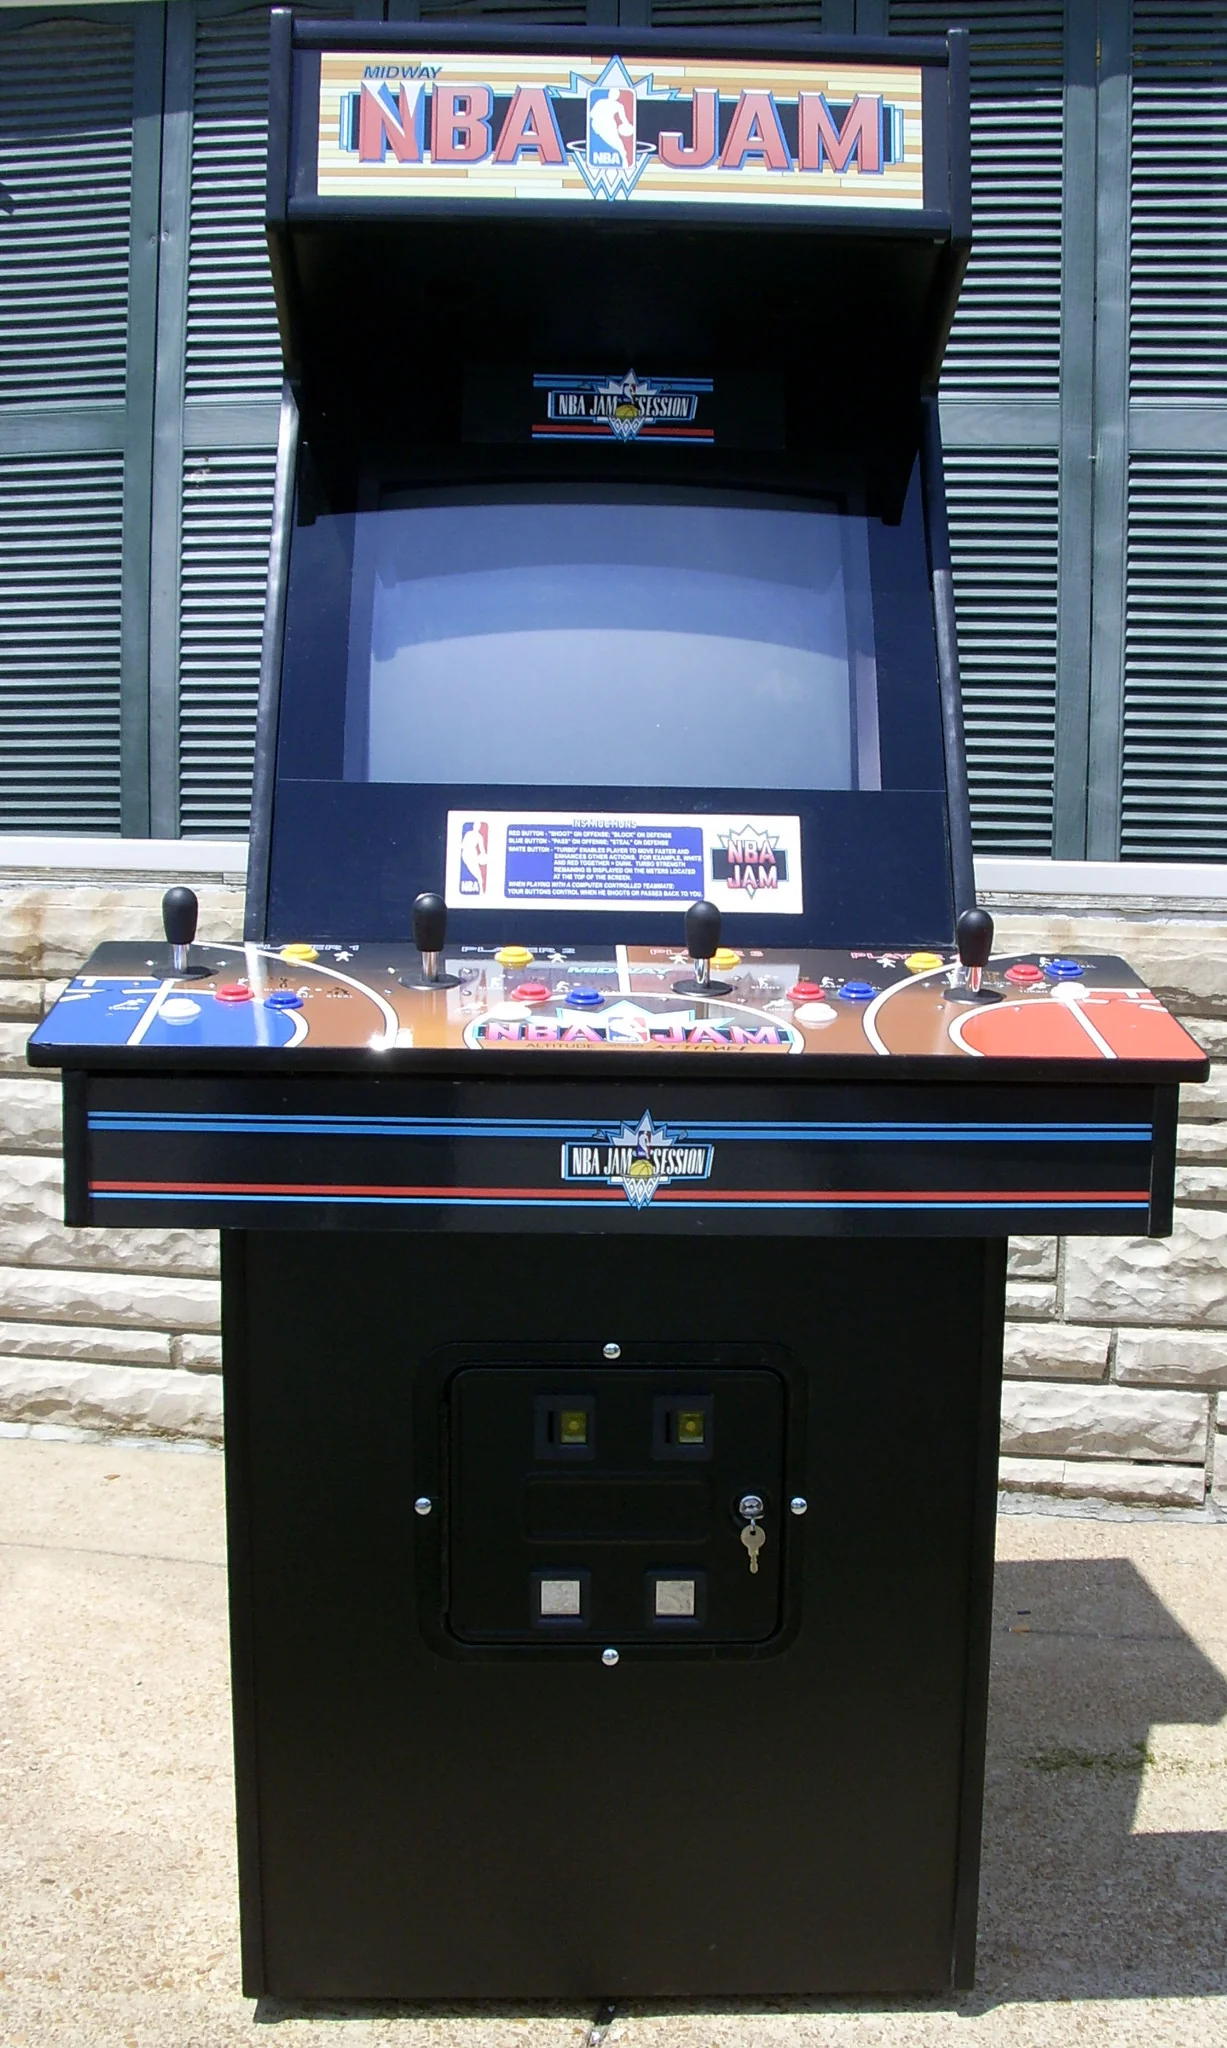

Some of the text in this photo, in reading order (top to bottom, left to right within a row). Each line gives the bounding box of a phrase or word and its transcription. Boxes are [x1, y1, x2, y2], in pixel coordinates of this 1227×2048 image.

[363, 65, 443, 80] MIDWAY
[359, 81, 886, 176] NBA JAM
[592, 151, 620, 166] NBA
[558, 394, 690, 418] NBA JAM SESSION
[572, 819, 637, 829] INSTRUCTIONS
[727, 839, 776, 864] NBA
[727, 864, 778, 889] JAM
[461, 946, 556, 954] PLAER
[567, 967, 671, 976] MIDWAY
[485, 1021, 780, 1045] NBA JAM
[572, 1147, 706, 1175] NBA JAM SESSION
